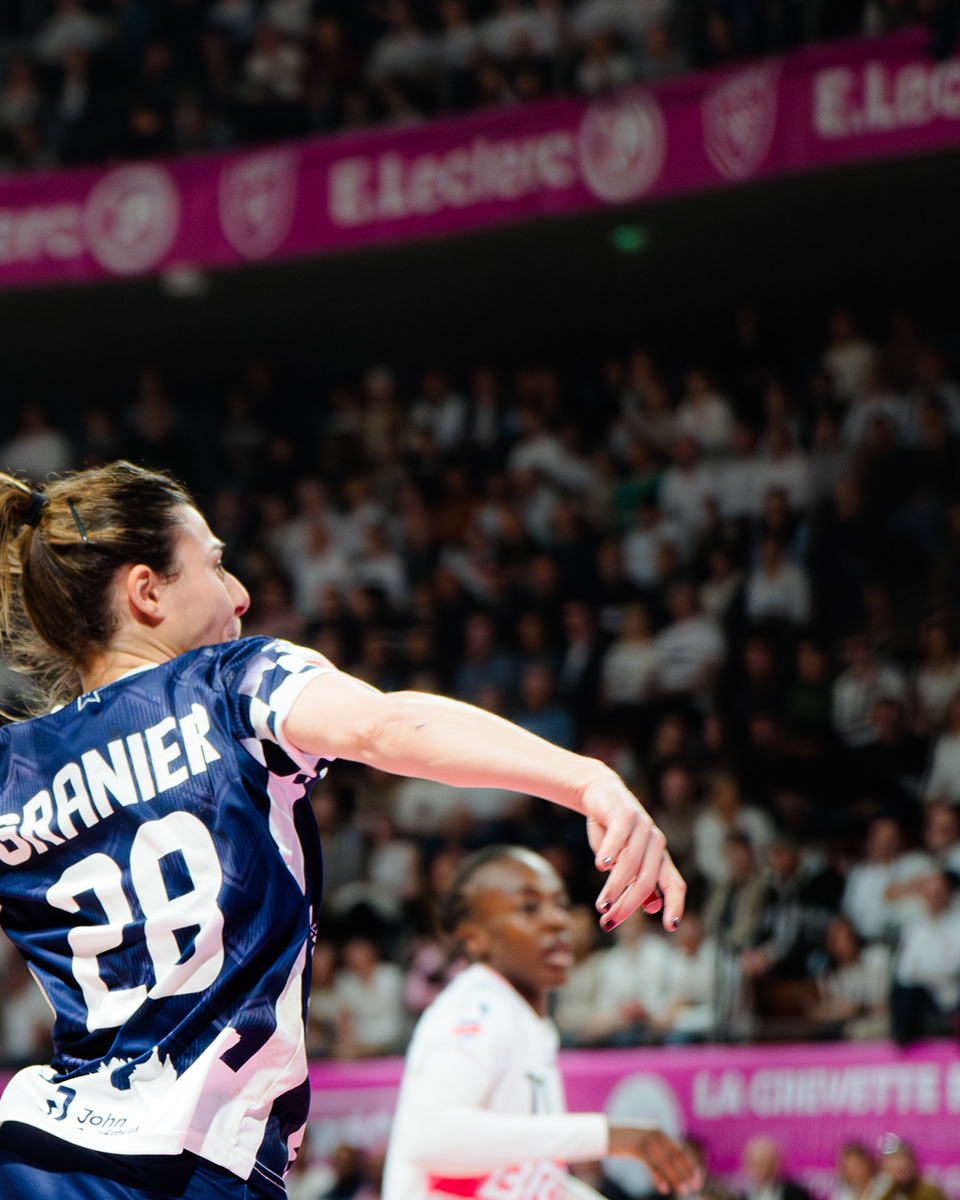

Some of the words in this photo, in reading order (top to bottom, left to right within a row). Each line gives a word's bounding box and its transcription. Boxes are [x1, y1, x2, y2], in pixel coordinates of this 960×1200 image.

[328, 131, 576, 226] E.Leclerc
[46, 811, 225, 1033] 28
[77, 1108, 128, 1128] John
